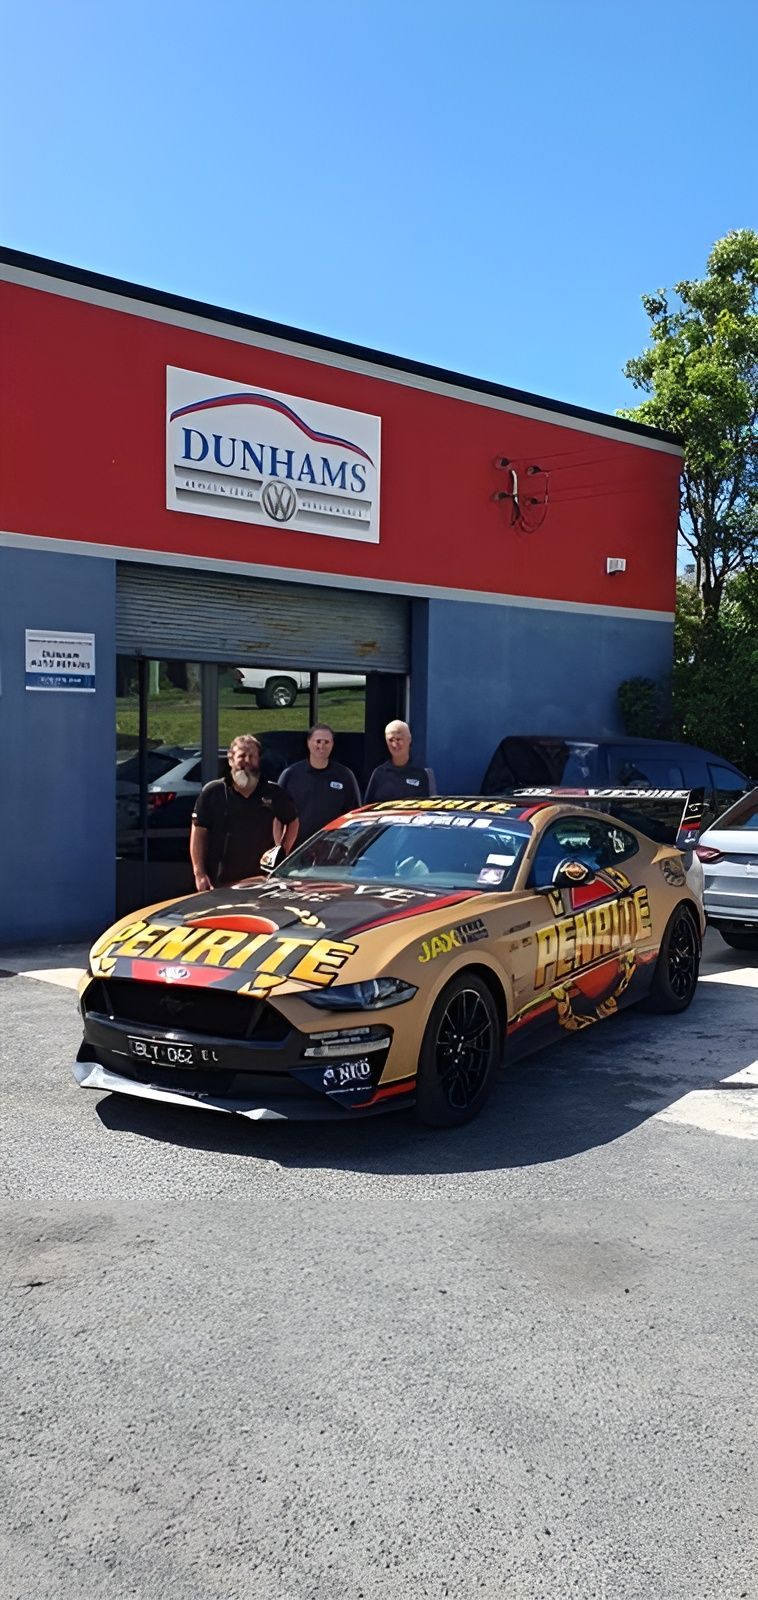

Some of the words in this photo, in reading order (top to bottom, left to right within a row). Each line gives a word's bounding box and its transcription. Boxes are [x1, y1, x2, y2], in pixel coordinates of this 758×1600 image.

[181, 426, 367, 493] DUNHAMS
[372, 799, 517, 815] PENRITE
[91, 919, 360, 988] PENRITE
[418, 929, 463, 963] JAX
